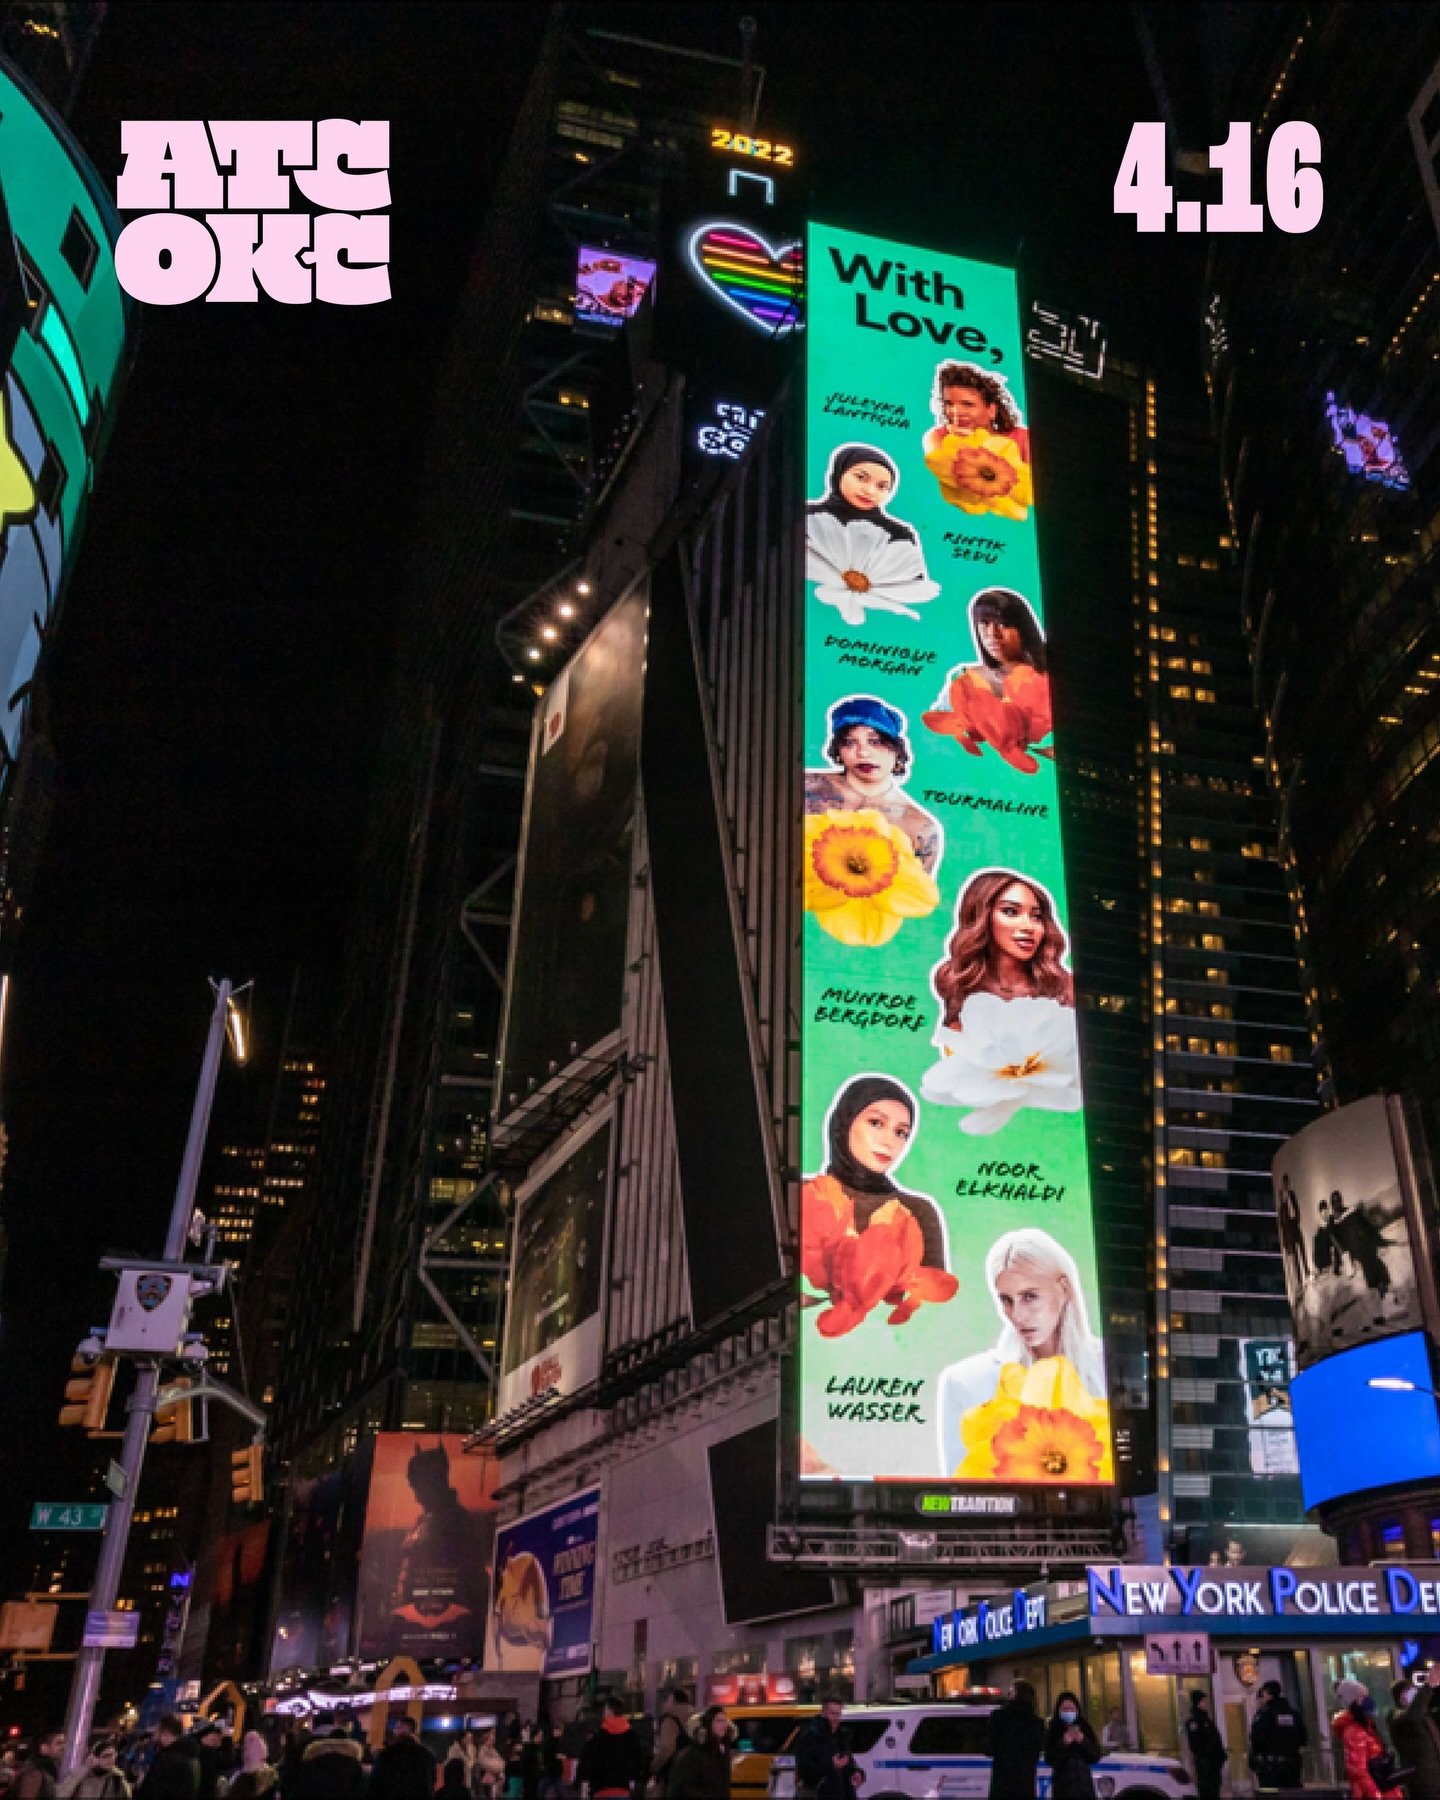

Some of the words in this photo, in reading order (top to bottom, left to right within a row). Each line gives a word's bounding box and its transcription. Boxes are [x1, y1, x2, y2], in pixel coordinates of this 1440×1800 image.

[711, 128, 794, 167] 2022
[828, 247, 965, 310] With
[855, 292, 1004, 364] Love,
[824, 634, 937, 664] DOMINIQUE
[838, 653, 923, 676] MORGAN
[922, 788, 1049, 819] TOURMALINE
[821, 987, 917, 1010] MUNROE
[814, 1005, 926, 1033] BERGDORF
[977, 1160, 1045, 1181] NOOR
[955, 1178, 1067, 1203] ELKHALDI
[825, 1375, 926, 1398] LAUREN
[827, 1401, 928, 1425] WASSER
[37, 1507, 52, 1527] W
[58, 1507, 83, 1528] 43
[1087, 1566, 1169, 1616] NEW
[1167, 1566, 1264, 1616] YORK
[1268, 1566, 1379, 1616] POLICE
[1382, 1566, 1440, 1616] DE
